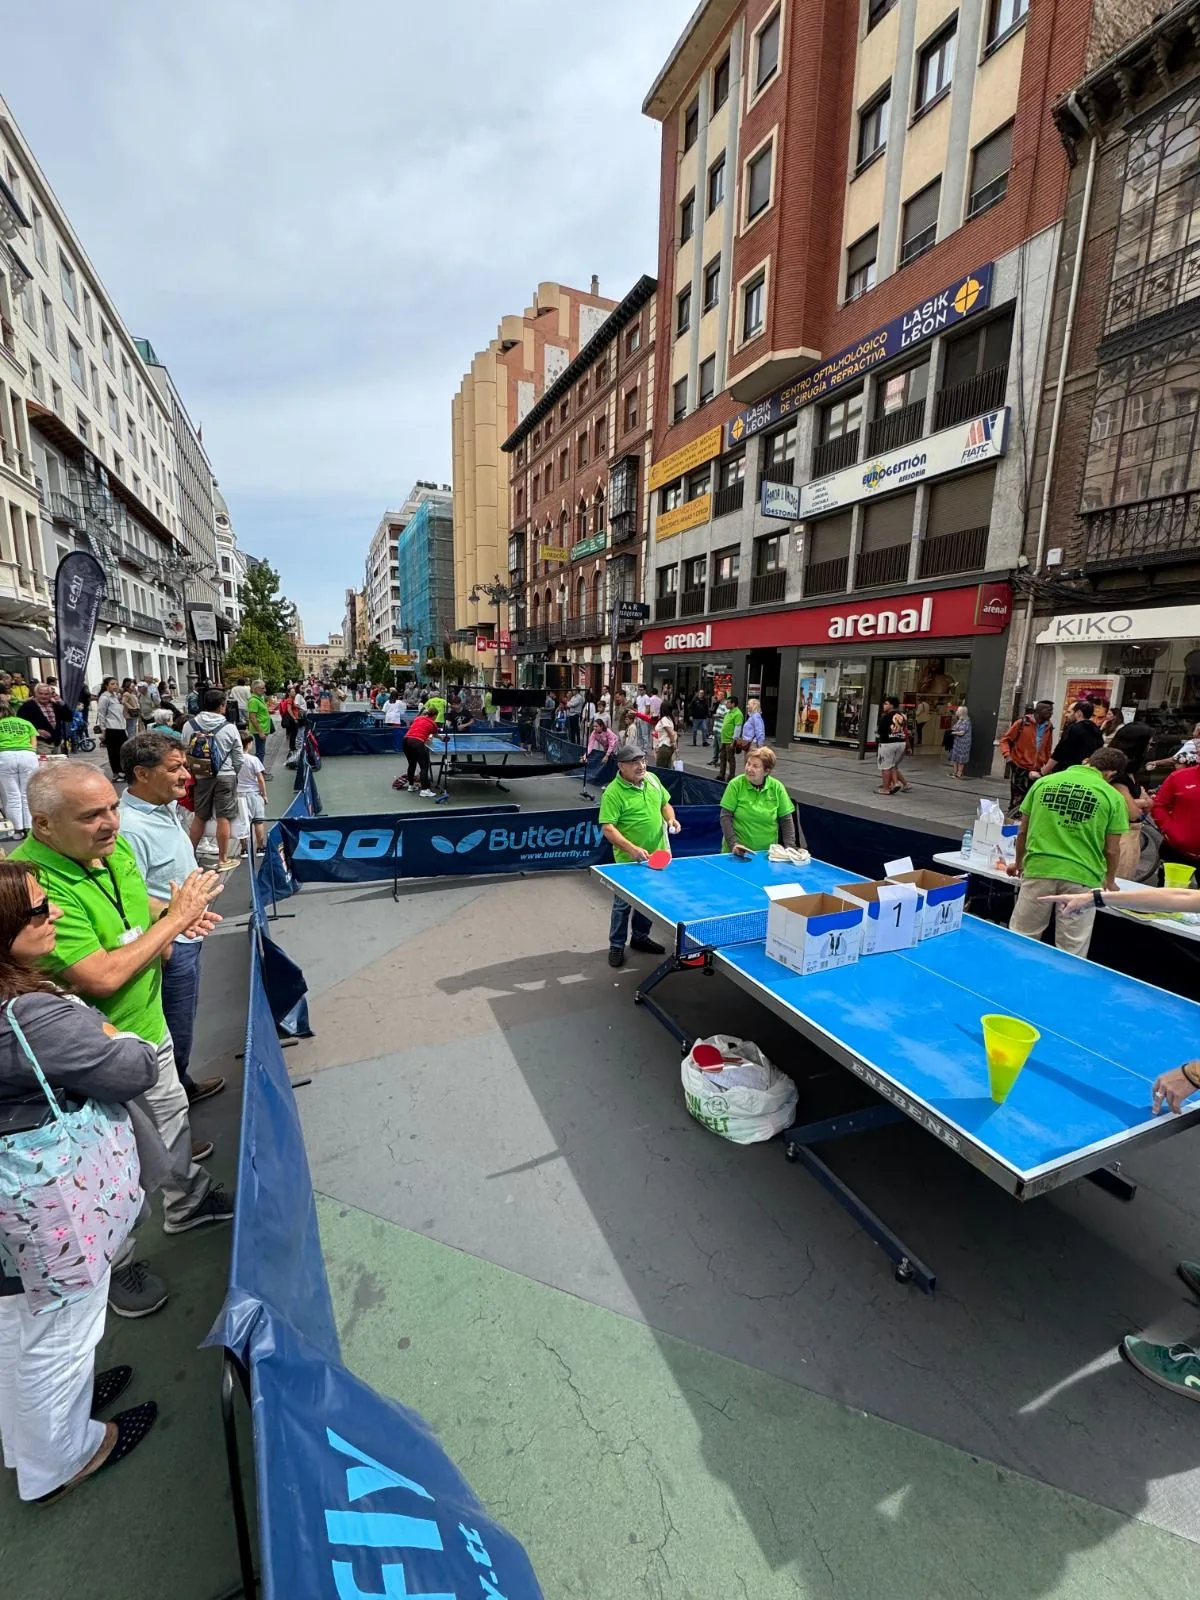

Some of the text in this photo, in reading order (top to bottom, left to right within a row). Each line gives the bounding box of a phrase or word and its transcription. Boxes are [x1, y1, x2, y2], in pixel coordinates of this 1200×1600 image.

[903, 291, 949, 331] LASIK
[901, 309, 947, 347] LEON
[780, 331, 888, 400] CENTRO OFTALMOLÓGICO
[780, 402, 790, 414] DE
[830, 347, 886, 384] REFRACTIVA
[745, 411, 771, 434] LEON
[746, 399, 771, 423] LASIK
[961, 443, 990, 460] FIATC
[828, 598, 933, 638] arenal
[983, 605, 1007, 614] arenal
[664, 625, 712, 650] arenal
[1056, 615, 1133, 636] KIKO
[489, 821, 604, 851] Butterfly
[520, 850, 590, 861] www.butterfly.tt
[893, 902, 902, 928] 1
[851, 1061, 922, 1120] ENEBE
